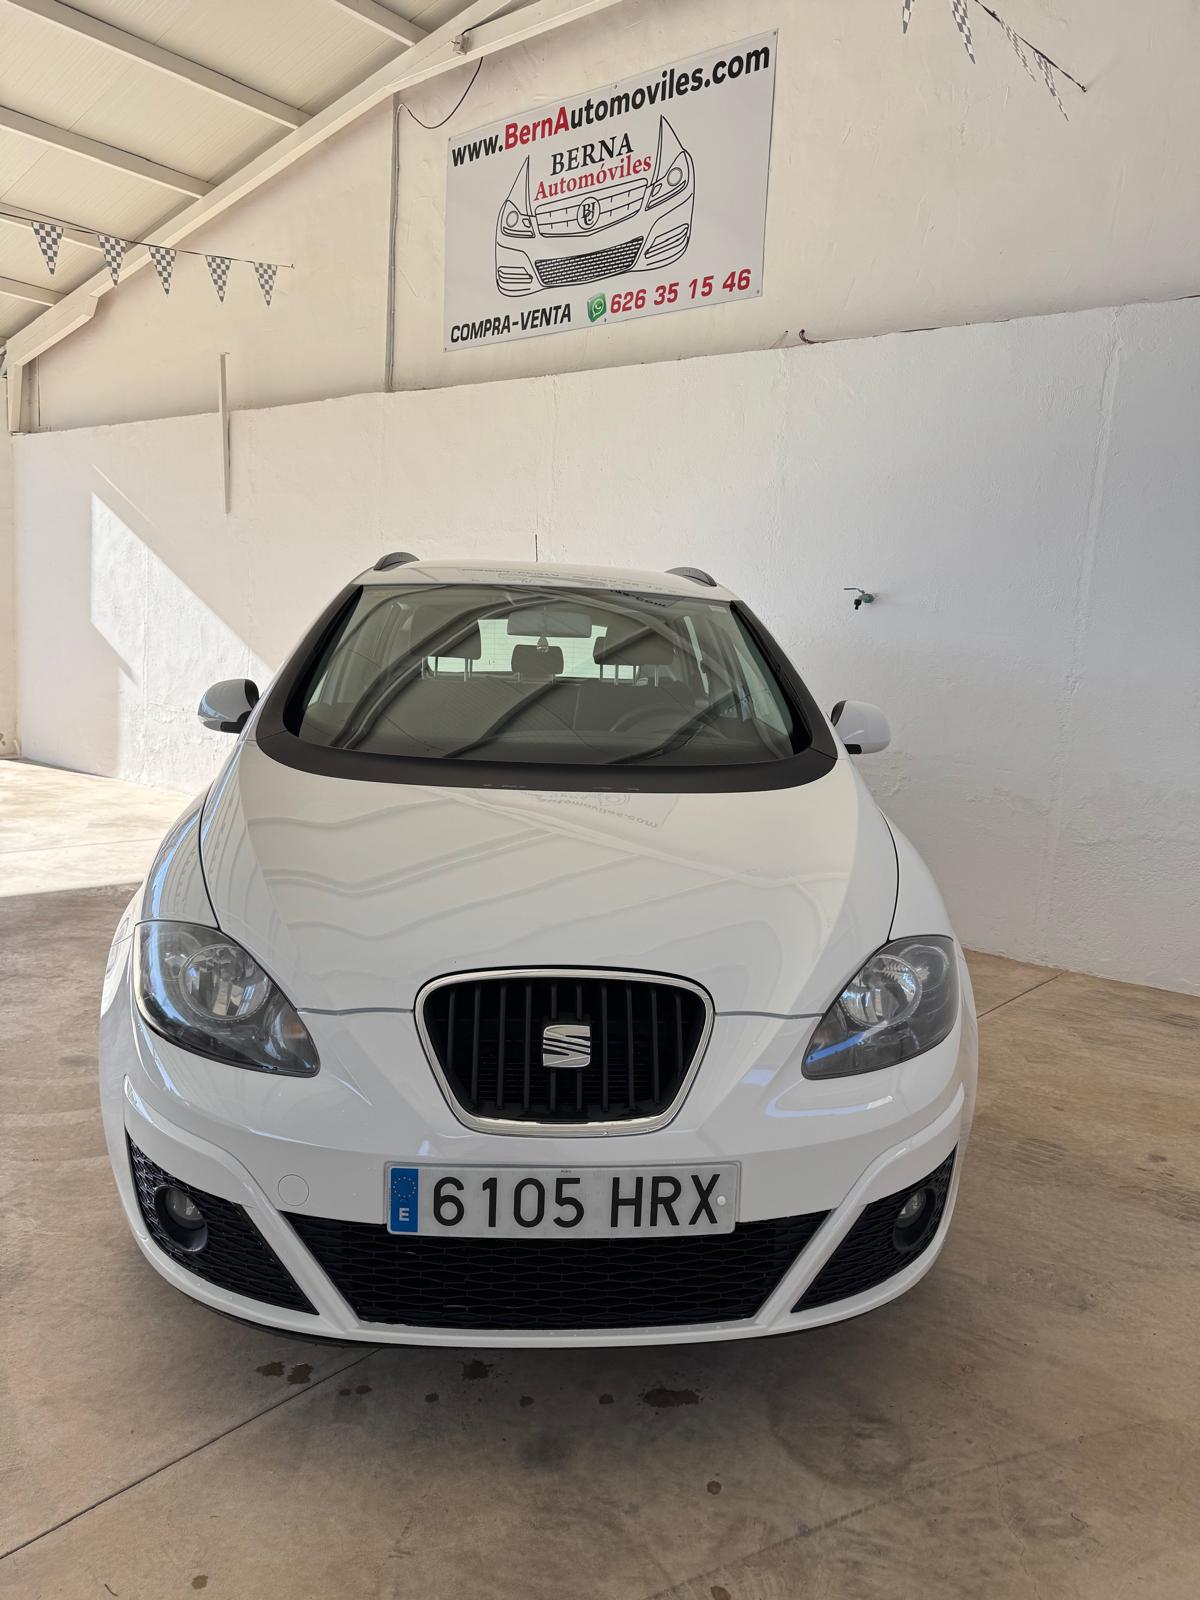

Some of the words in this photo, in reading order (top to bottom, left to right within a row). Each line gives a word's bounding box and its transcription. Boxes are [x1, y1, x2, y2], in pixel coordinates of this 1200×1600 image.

[452, 46, 770, 168] www.BernAutomoviles.com
[550, 132, 634, 177] BERNA
[534, 154, 652, 202] Automóviles
[611, 289, 647, 314] 626
[654, 283, 680, 306] 35
[689, 276, 715, 300] 15
[723, 269, 751, 293] 46
[450, 303, 571, 343] COMPRA-VENTA
[399, 1207, 410, 1222] E
[433, 1177, 585, 1228] 6105
[611, 1174, 720, 1228] HRX
